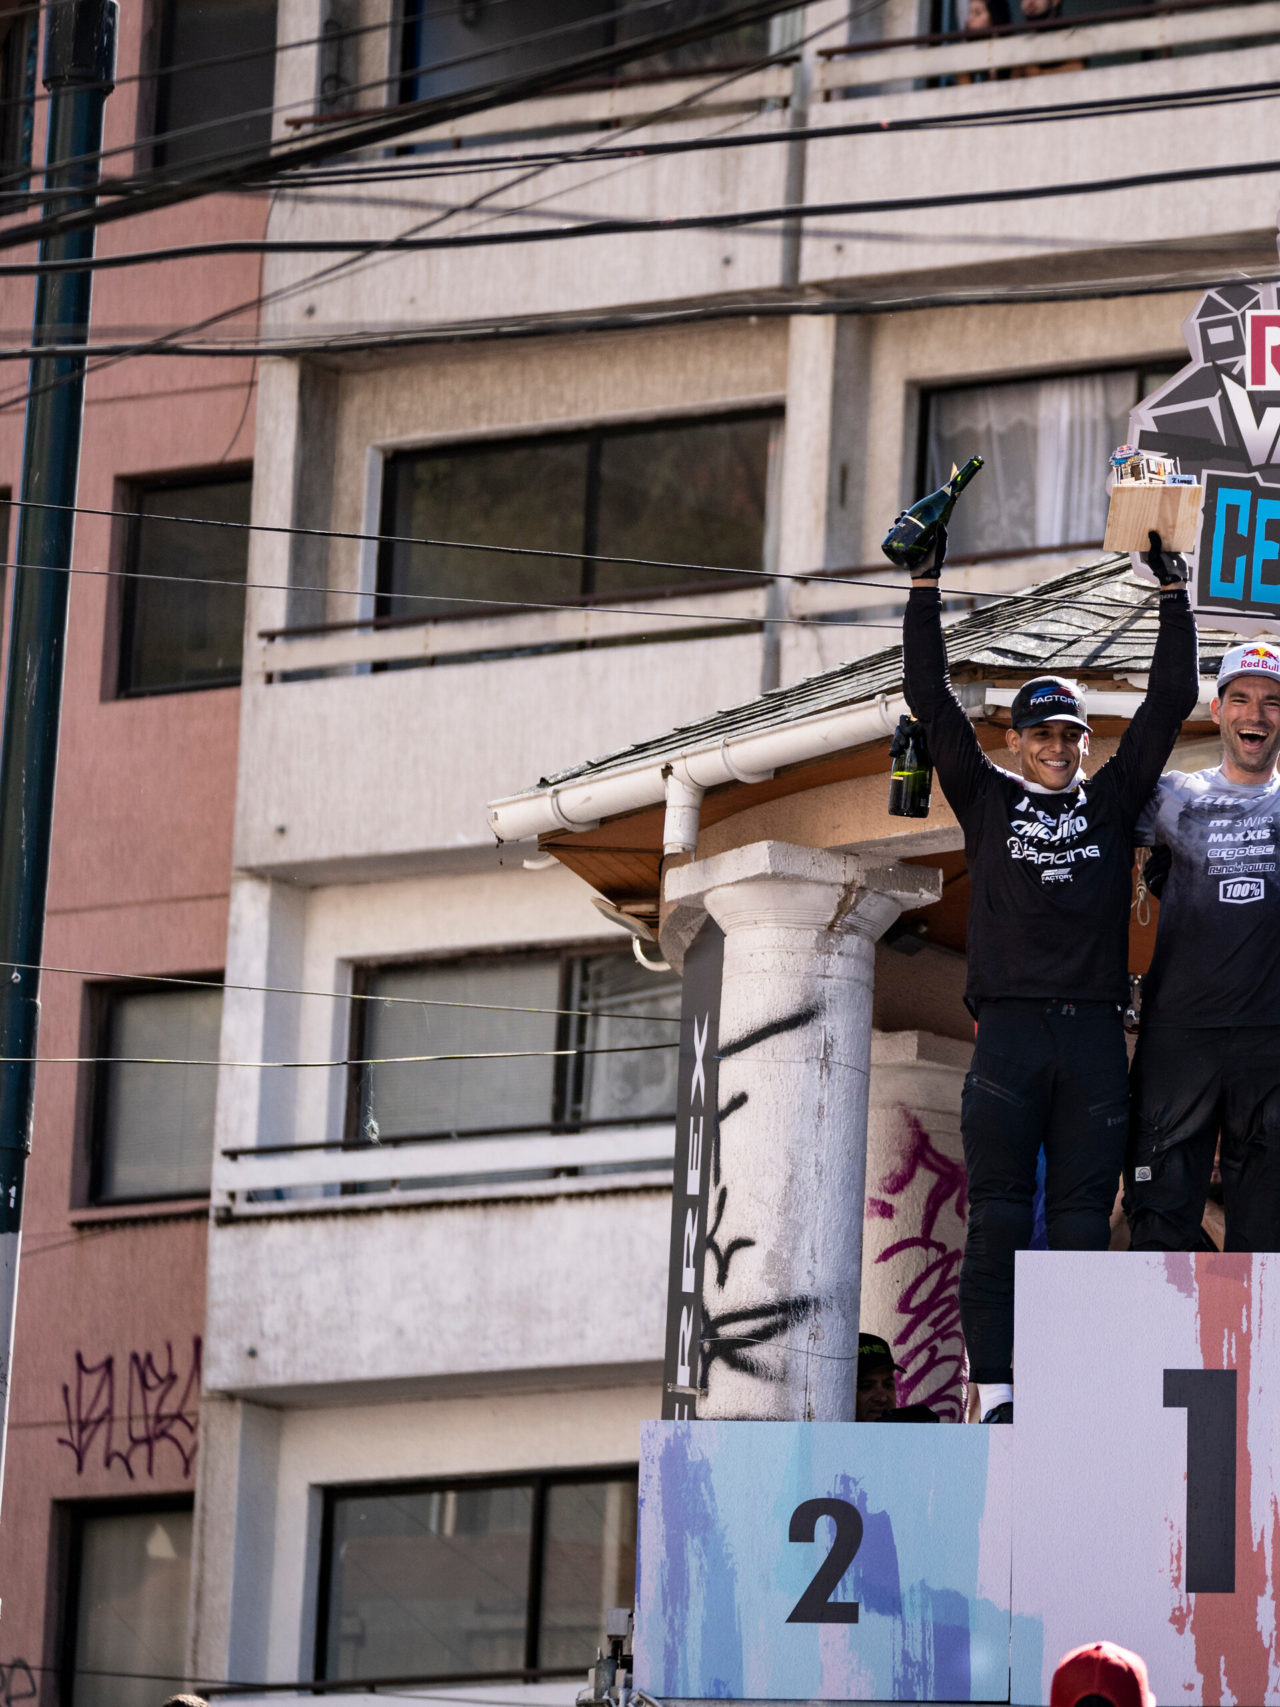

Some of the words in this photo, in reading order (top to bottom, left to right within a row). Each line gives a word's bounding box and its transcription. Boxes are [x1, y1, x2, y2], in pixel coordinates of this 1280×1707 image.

[1240, 659, 1260, 669] Red
[1261, 659, 1279, 672] Bull
[1030, 694, 1081, 707] FACTORY
[1207, 828, 1272, 843] MAXXIS
[1022, 845, 1101, 865] RACING
[1207, 844, 1276, 861] ergotec
[1225, 882, 1261, 899] 100%
[1163, 1368, 1237, 1593] 1
[785, 1497, 864, 1624] 2
